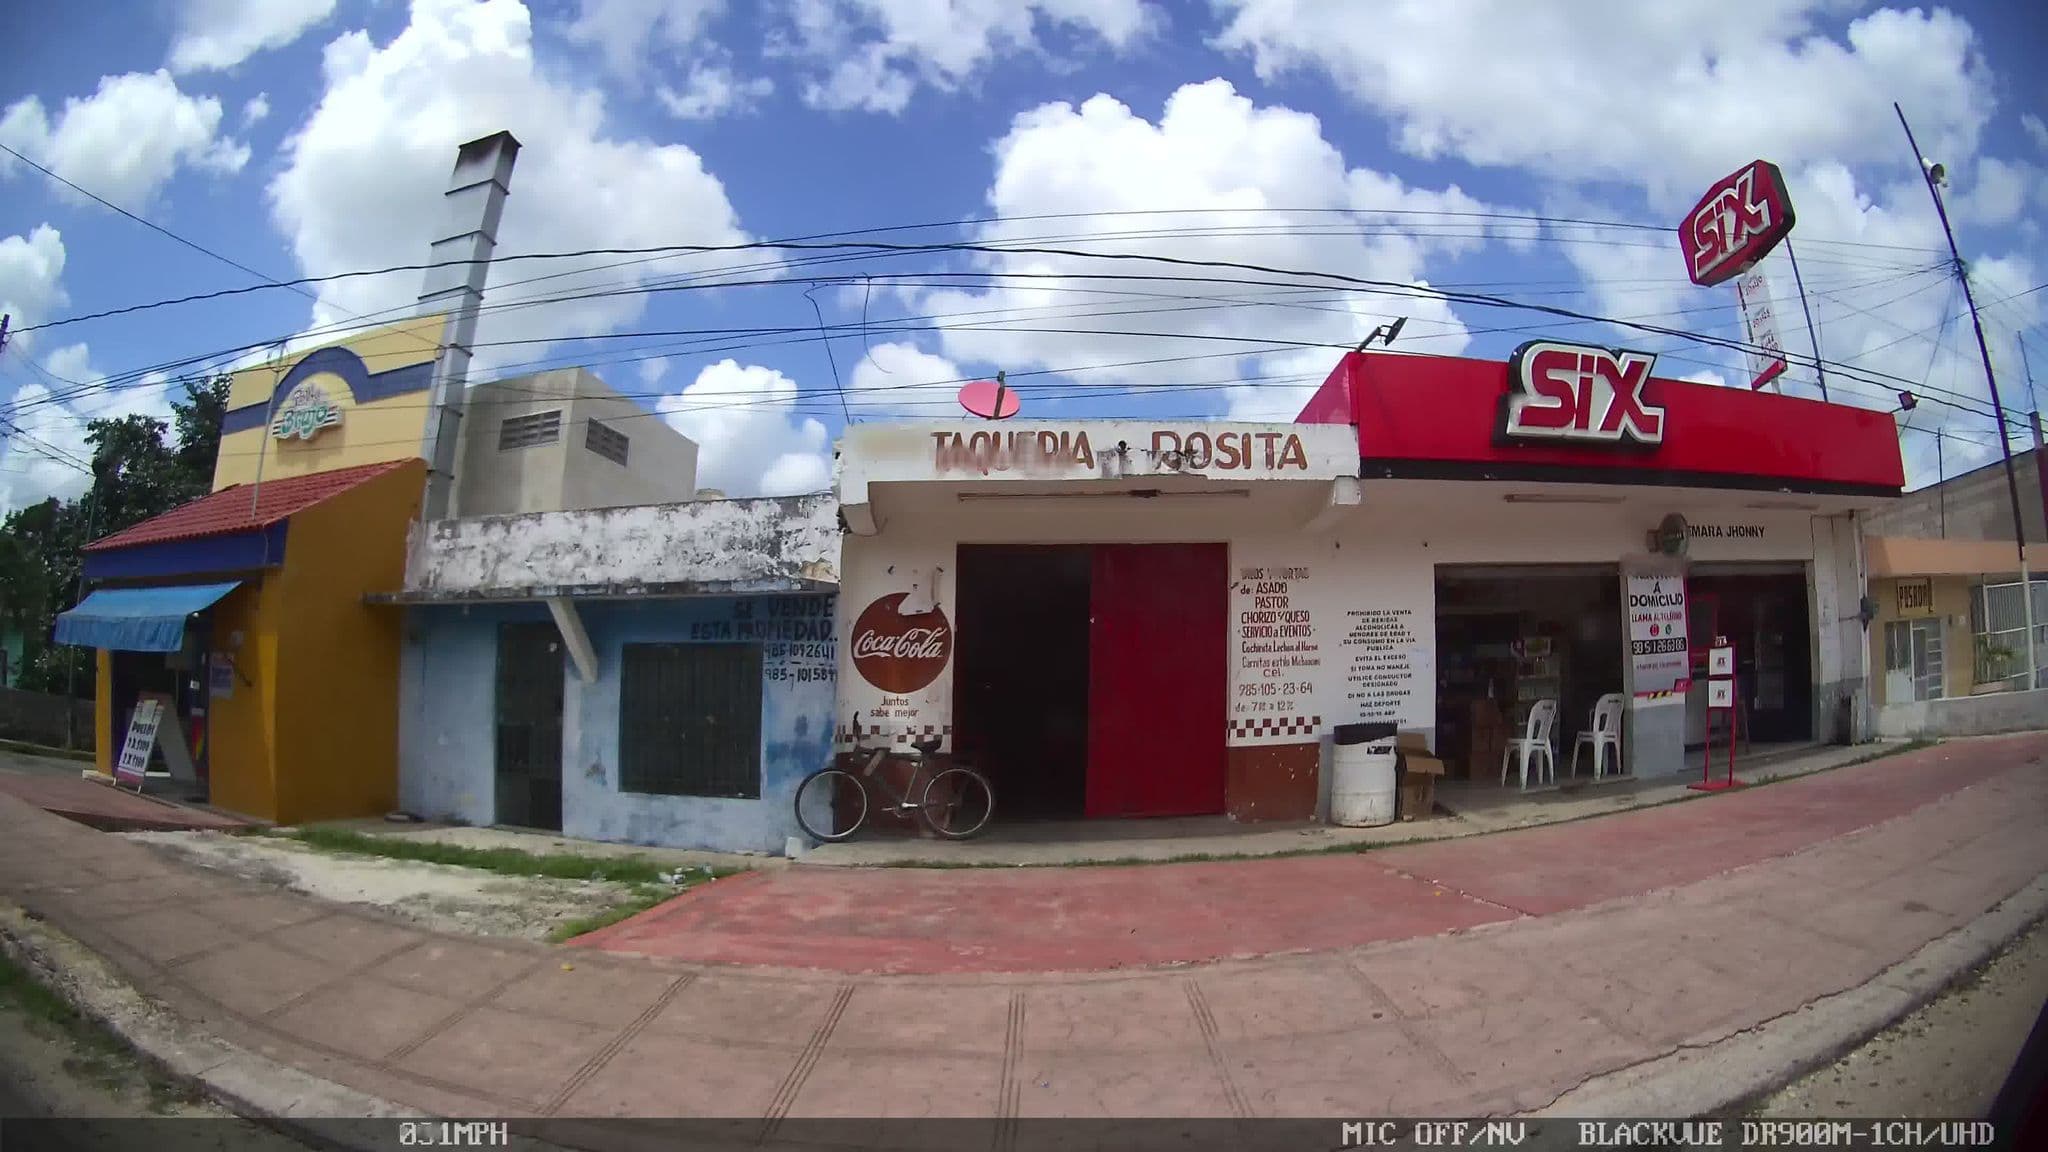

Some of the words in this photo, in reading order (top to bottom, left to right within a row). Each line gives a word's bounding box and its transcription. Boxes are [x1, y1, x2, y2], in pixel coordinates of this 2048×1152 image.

[1152, 431, 1308, 471] ROSITA
[1726, 525, 1765, 538] JHONNY
[1256, 582, 1288, 594] ASADO
[1653, 581, 1661, 594] A
[1255, 596, 1289, 609] PASTOR
[1630, 593, 1683, 608] DOMICILIO
[1241, 611, 1276, 624] CHORIZO
[1632, 613, 1652, 623] LLAMA
[1242, 625, 1273, 638] SERVICIO
[1280, 625, 1311, 638] EVENTOS
[881, 696, 909, 706] Juntos
[870, 707, 890, 718] sabe
[894, 708, 920, 718] mejor
